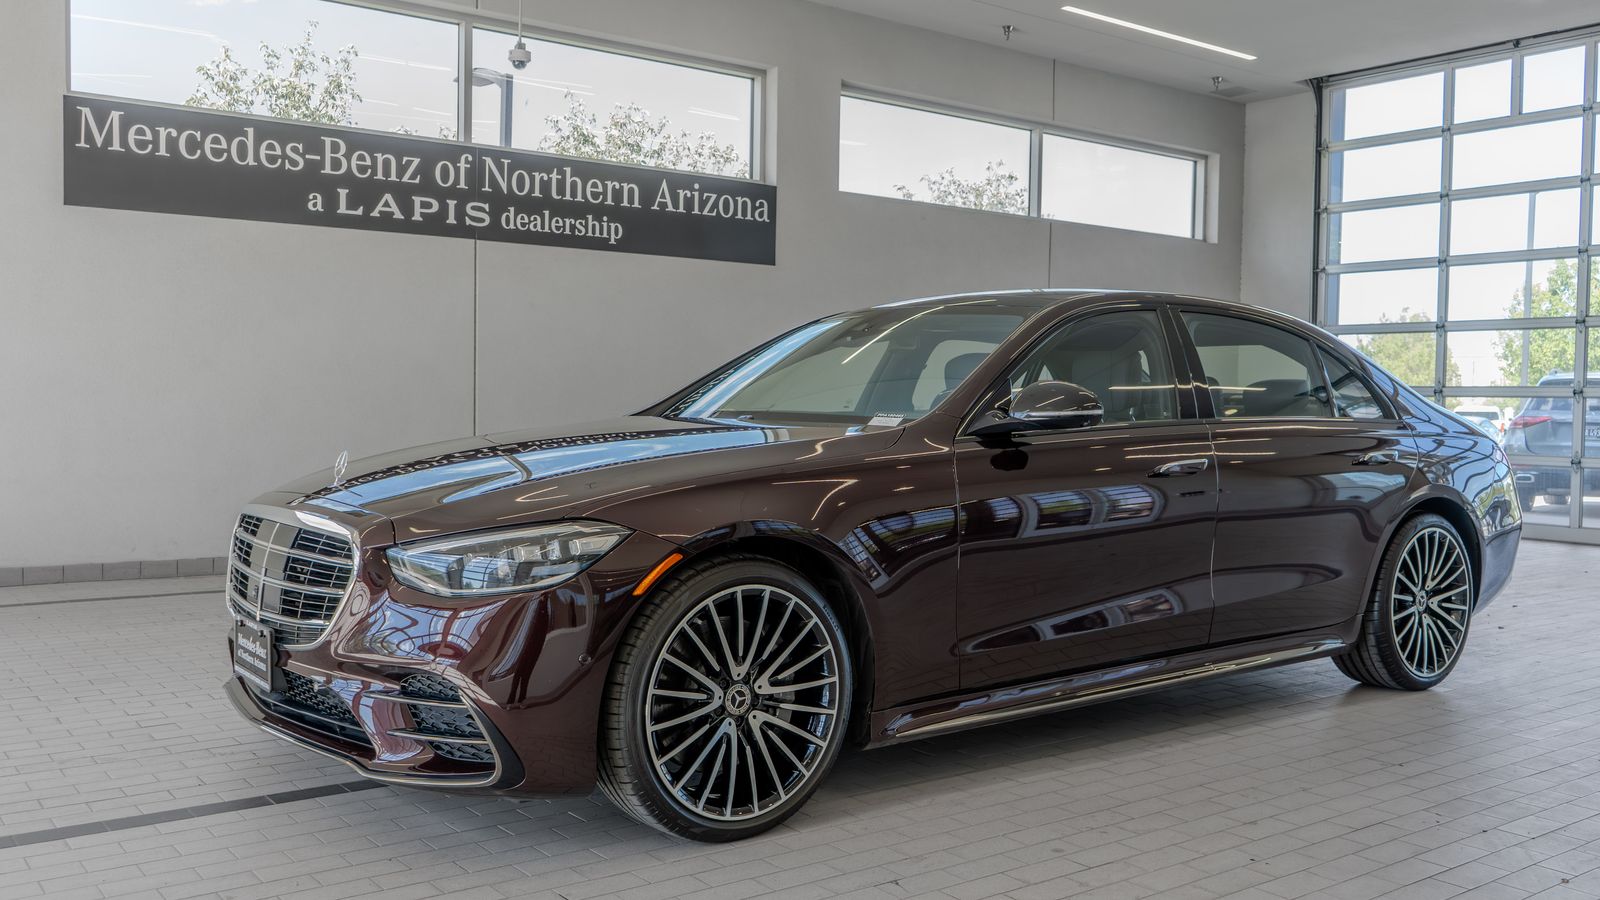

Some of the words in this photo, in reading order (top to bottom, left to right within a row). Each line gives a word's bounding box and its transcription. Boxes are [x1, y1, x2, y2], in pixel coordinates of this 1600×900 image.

[75, 106, 421, 184] Mercedes-Benz
[434, 154, 473, 189] of
[481, 156, 642, 209] Northern
[651, 178, 771, 223] Arizona
[307, 192, 324, 212] a
[336, 188, 491, 227] LAPIS
[501, 207, 623, 245] dealership
